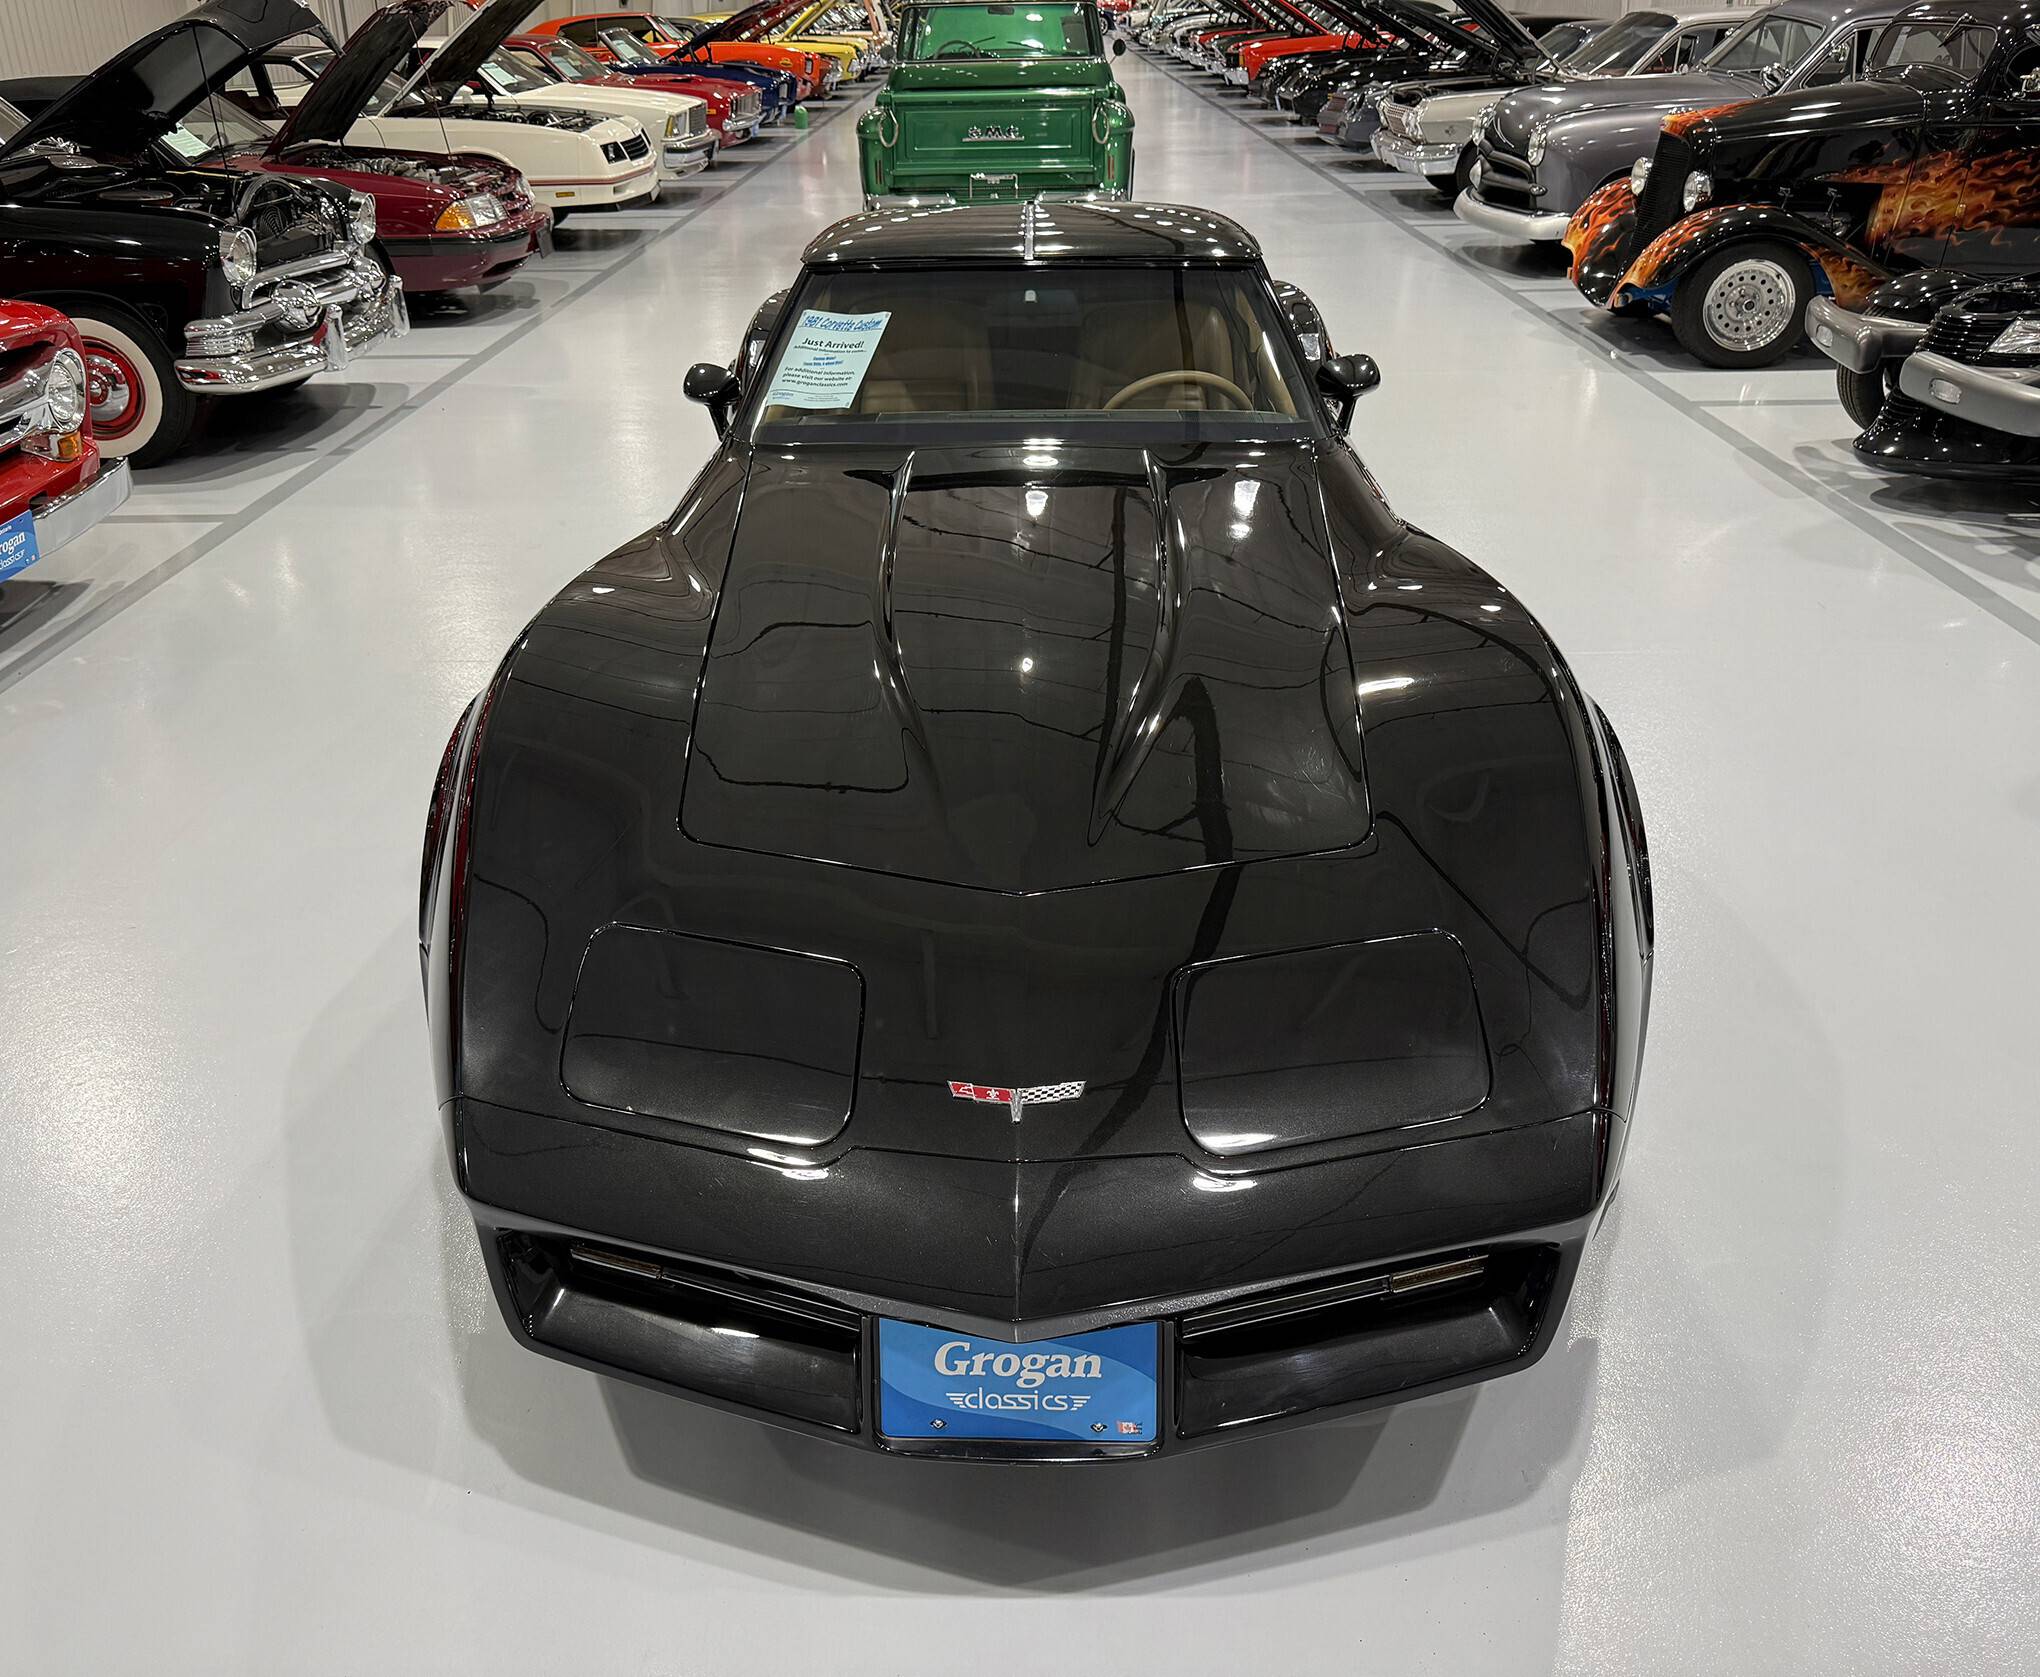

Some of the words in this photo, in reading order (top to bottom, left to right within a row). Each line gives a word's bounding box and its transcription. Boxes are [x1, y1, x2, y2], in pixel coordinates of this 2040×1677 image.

[820, 317, 855, 332] Corvette
[853, 318, 882, 331] Custom
[802, 337, 823, 347] Just
[824, 340, 865, 349] Arrived!
[794, 367, 823, 375] additional
[782, 379, 848, 387] www.groganclassics.com
[0, 531, 26, 555] rogan
[934, 1341, 1102, 1389] Grogan
[964, 1387, 1069, 1411] classics
